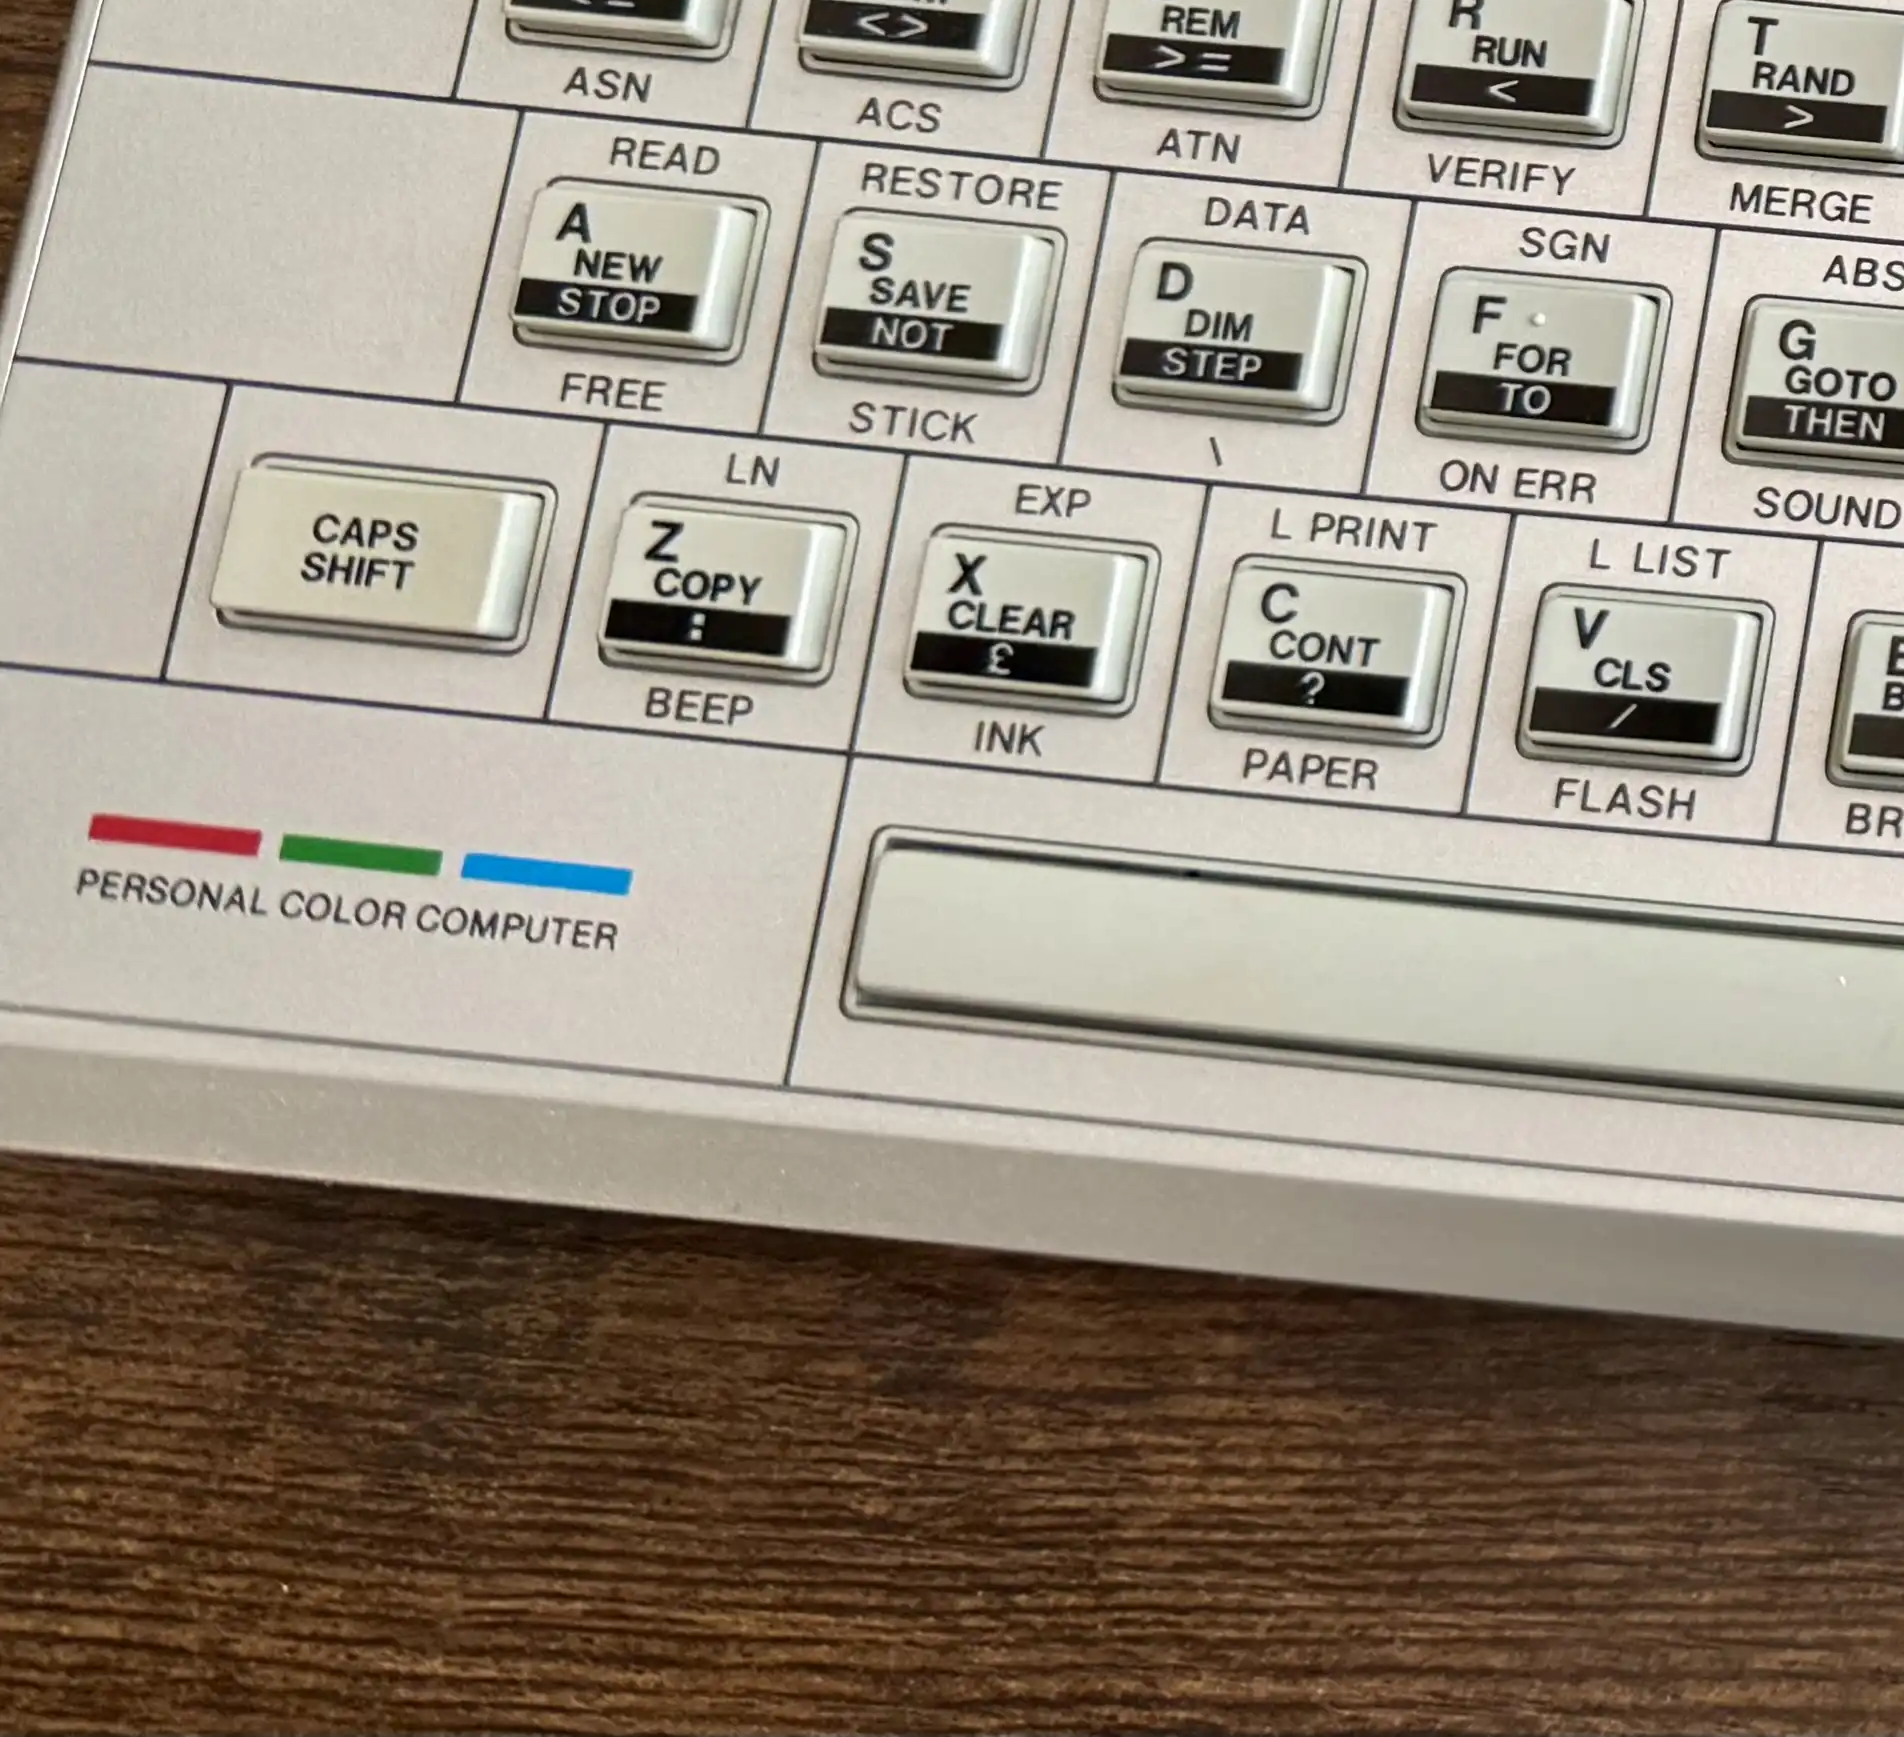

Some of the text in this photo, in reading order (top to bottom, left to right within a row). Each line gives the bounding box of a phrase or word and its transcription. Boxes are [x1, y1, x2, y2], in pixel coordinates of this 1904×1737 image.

[564, 67, 651, 102] ASN
[1753, 62, 1853, 97] RAND
[857, 98, 941, 133] ACS
[610, 137, 719, 174] READ
[1157, 129, 1240, 163] ATN
[861, 163, 1062, 210] RESTORE
[1428, 154, 1575, 195] VERIFY
[1205, 197, 1309, 235] DATA
[1730, 182, 1873, 224] MERGE
[574, 250, 661, 284] NEW
[559, 289, 659, 322] STOP
[870, 277, 970, 312] SAVE
[873, 318, 952, 350] NOT
[561, 373, 665, 411] FREE
[1786, 366, 1895, 401] GOTO
[849, 402, 977, 443] STICK
[1785, 405, 1884, 440] THEN
[1440, 460, 1595, 503] ON ERR
[1016, 484, 1090, 517] EXP
[1754, 487, 1901, 529] SOUND
[313, 514, 418, 551] CAPS
[301, 553, 414, 589] SHIFT
[655, 568, 760, 604] COPY
[949, 597, 1073, 639] CLEAR
[646, 688, 752, 724] BEEP
[976, 722, 1042, 754] INK
[1243, 748, 1377, 790] PAPER
[1555, 778, 1695, 820] FLASH
[77, 869, 617, 951] PERSONAL COLOR COMPUTER
